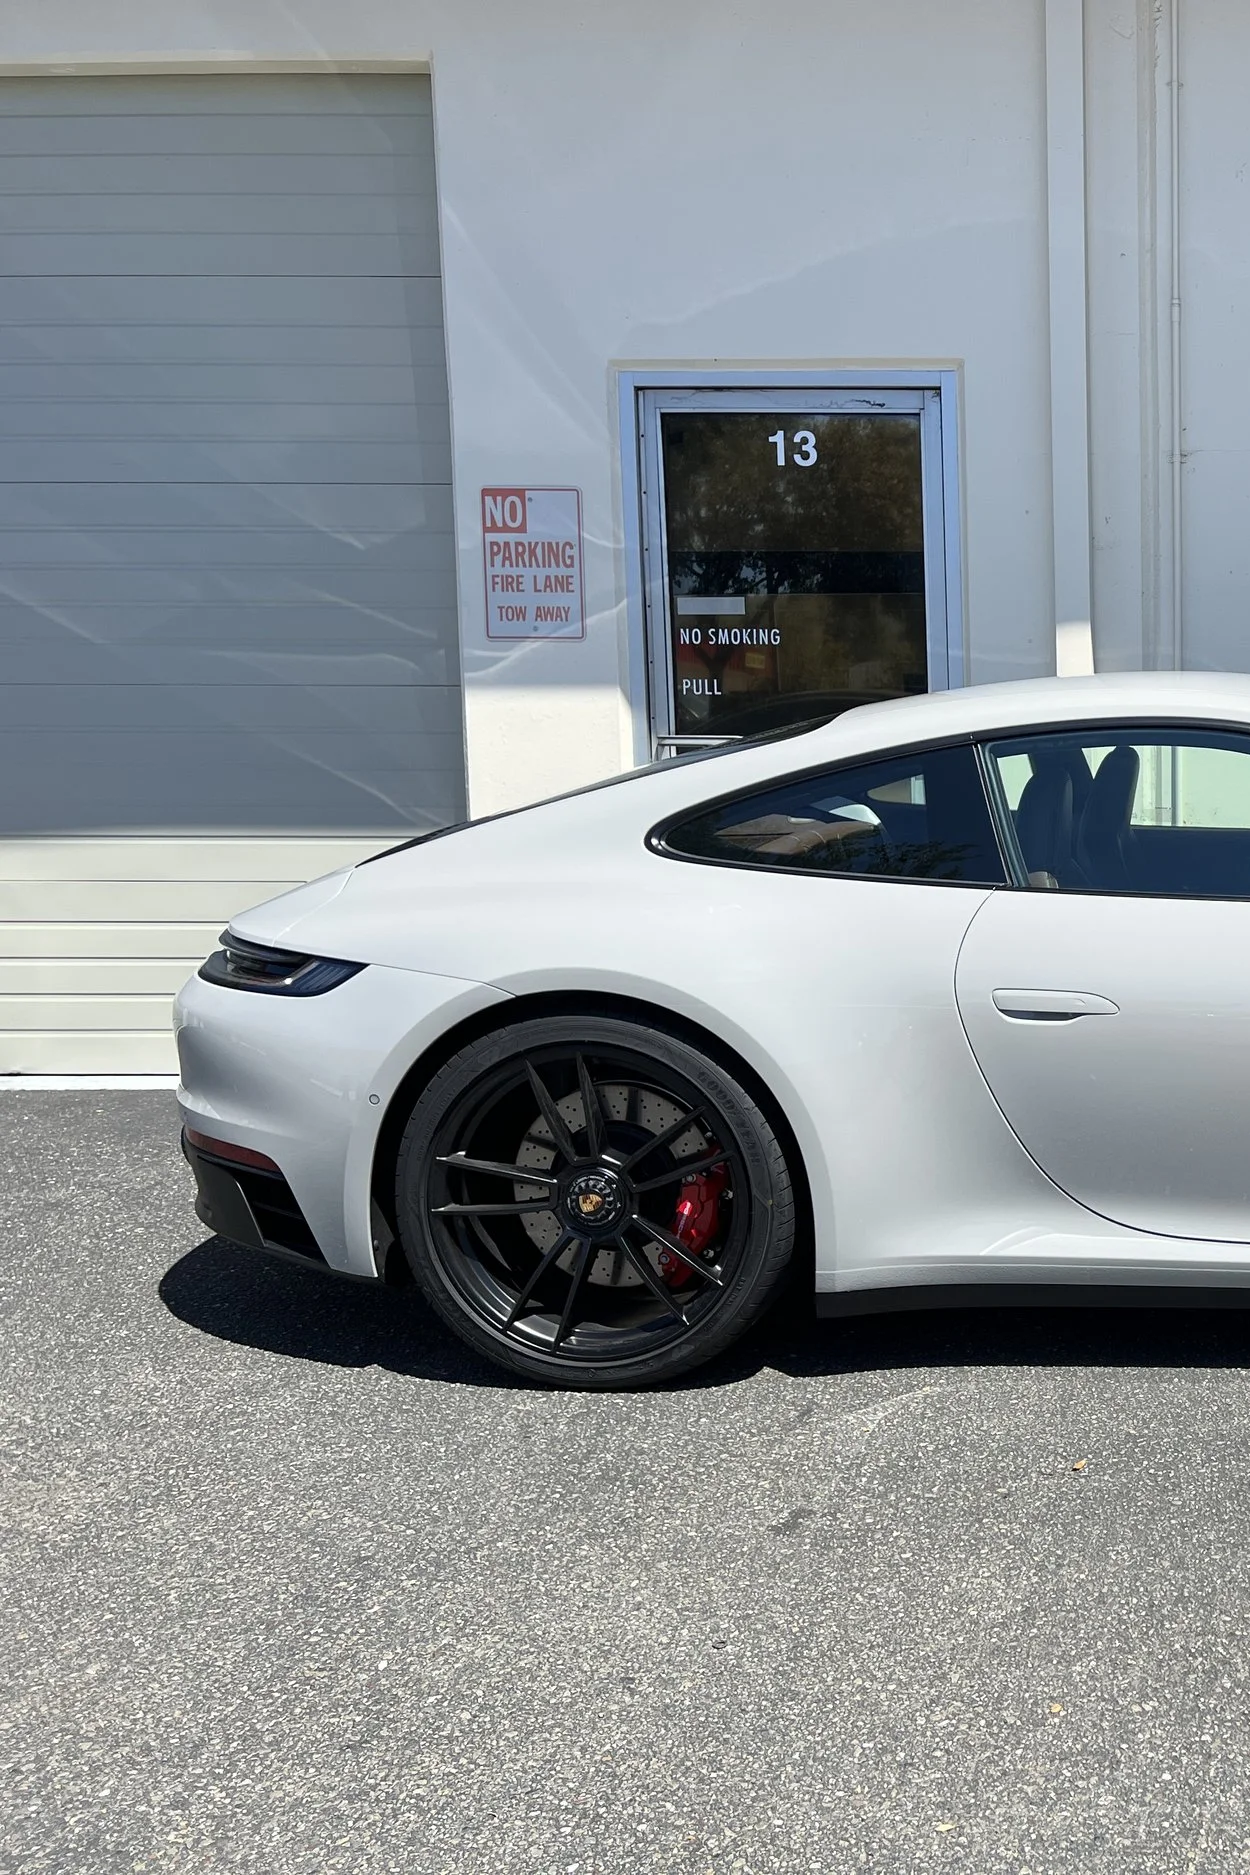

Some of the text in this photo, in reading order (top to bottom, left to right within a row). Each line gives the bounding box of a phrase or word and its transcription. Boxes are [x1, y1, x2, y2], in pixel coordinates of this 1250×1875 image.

[768, 430, 818, 467] 13
[484, 495, 523, 528] NO
[489, 541, 576, 569] PARKING
[491, 574, 575, 593] FIRE LANE
[497, 605, 571, 622] TOW AWAY
[680, 628, 781, 646] NO SMOKING
[682, 679, 722, 696] PULL
